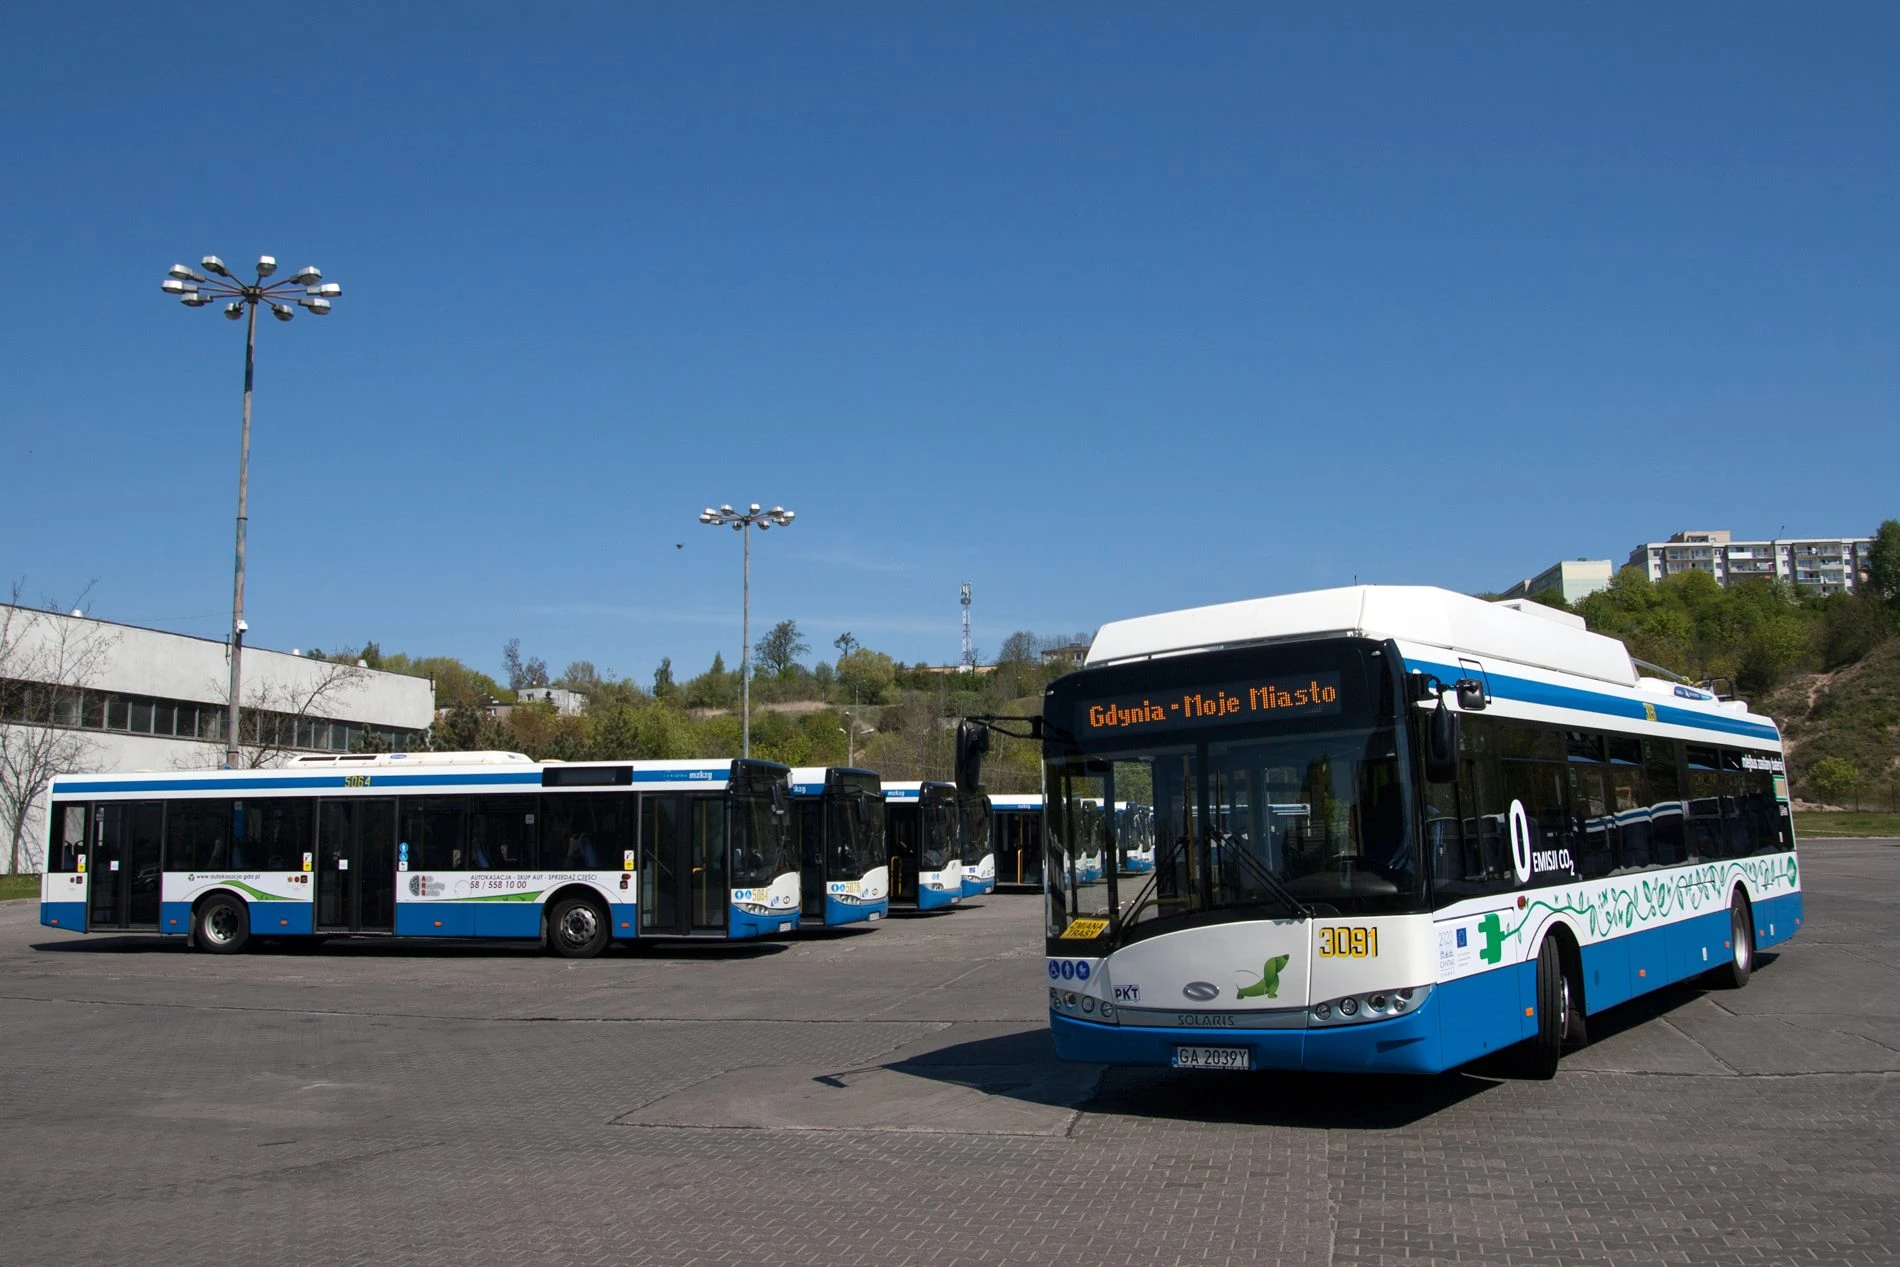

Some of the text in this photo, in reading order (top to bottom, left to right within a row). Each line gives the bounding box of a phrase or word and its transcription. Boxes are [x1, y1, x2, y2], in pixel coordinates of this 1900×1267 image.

[1089, 700, 1166, 728] Gdynia
[1184, 691, 1240, 718] Moje
[1249, 680, 1336, 711] Miasto
[689, 770, 713, 781] mzkzg
[344, 775, 372, 788] 5064
[793, 784, 806, 794] kzg
[1509, 799, 1531, 883] 0
[1532, 850, 1559, 873] EMISJI
[196, 873, 261, 881] wwwautokasacjagdapl
[548, 873, 576, 881] SPRZEDAŻ
[470, 880, 480, 889] 58
[488, 880, 503, 889] 558
[505, 880, 515, 889] 10
[516, 880, 527, 889] 00
[1070, 921, 1105, 930] ZMIANA
[1066, 929, 1097, 938] TRASY
[1319, 926, 1379, 959] 3091
[1115, 985, 1139, 1000] PKT
[1177, 1014, 1235, 1026] SOLARIS
[1179, 1048, 1247, 1066] GA 2039Y
